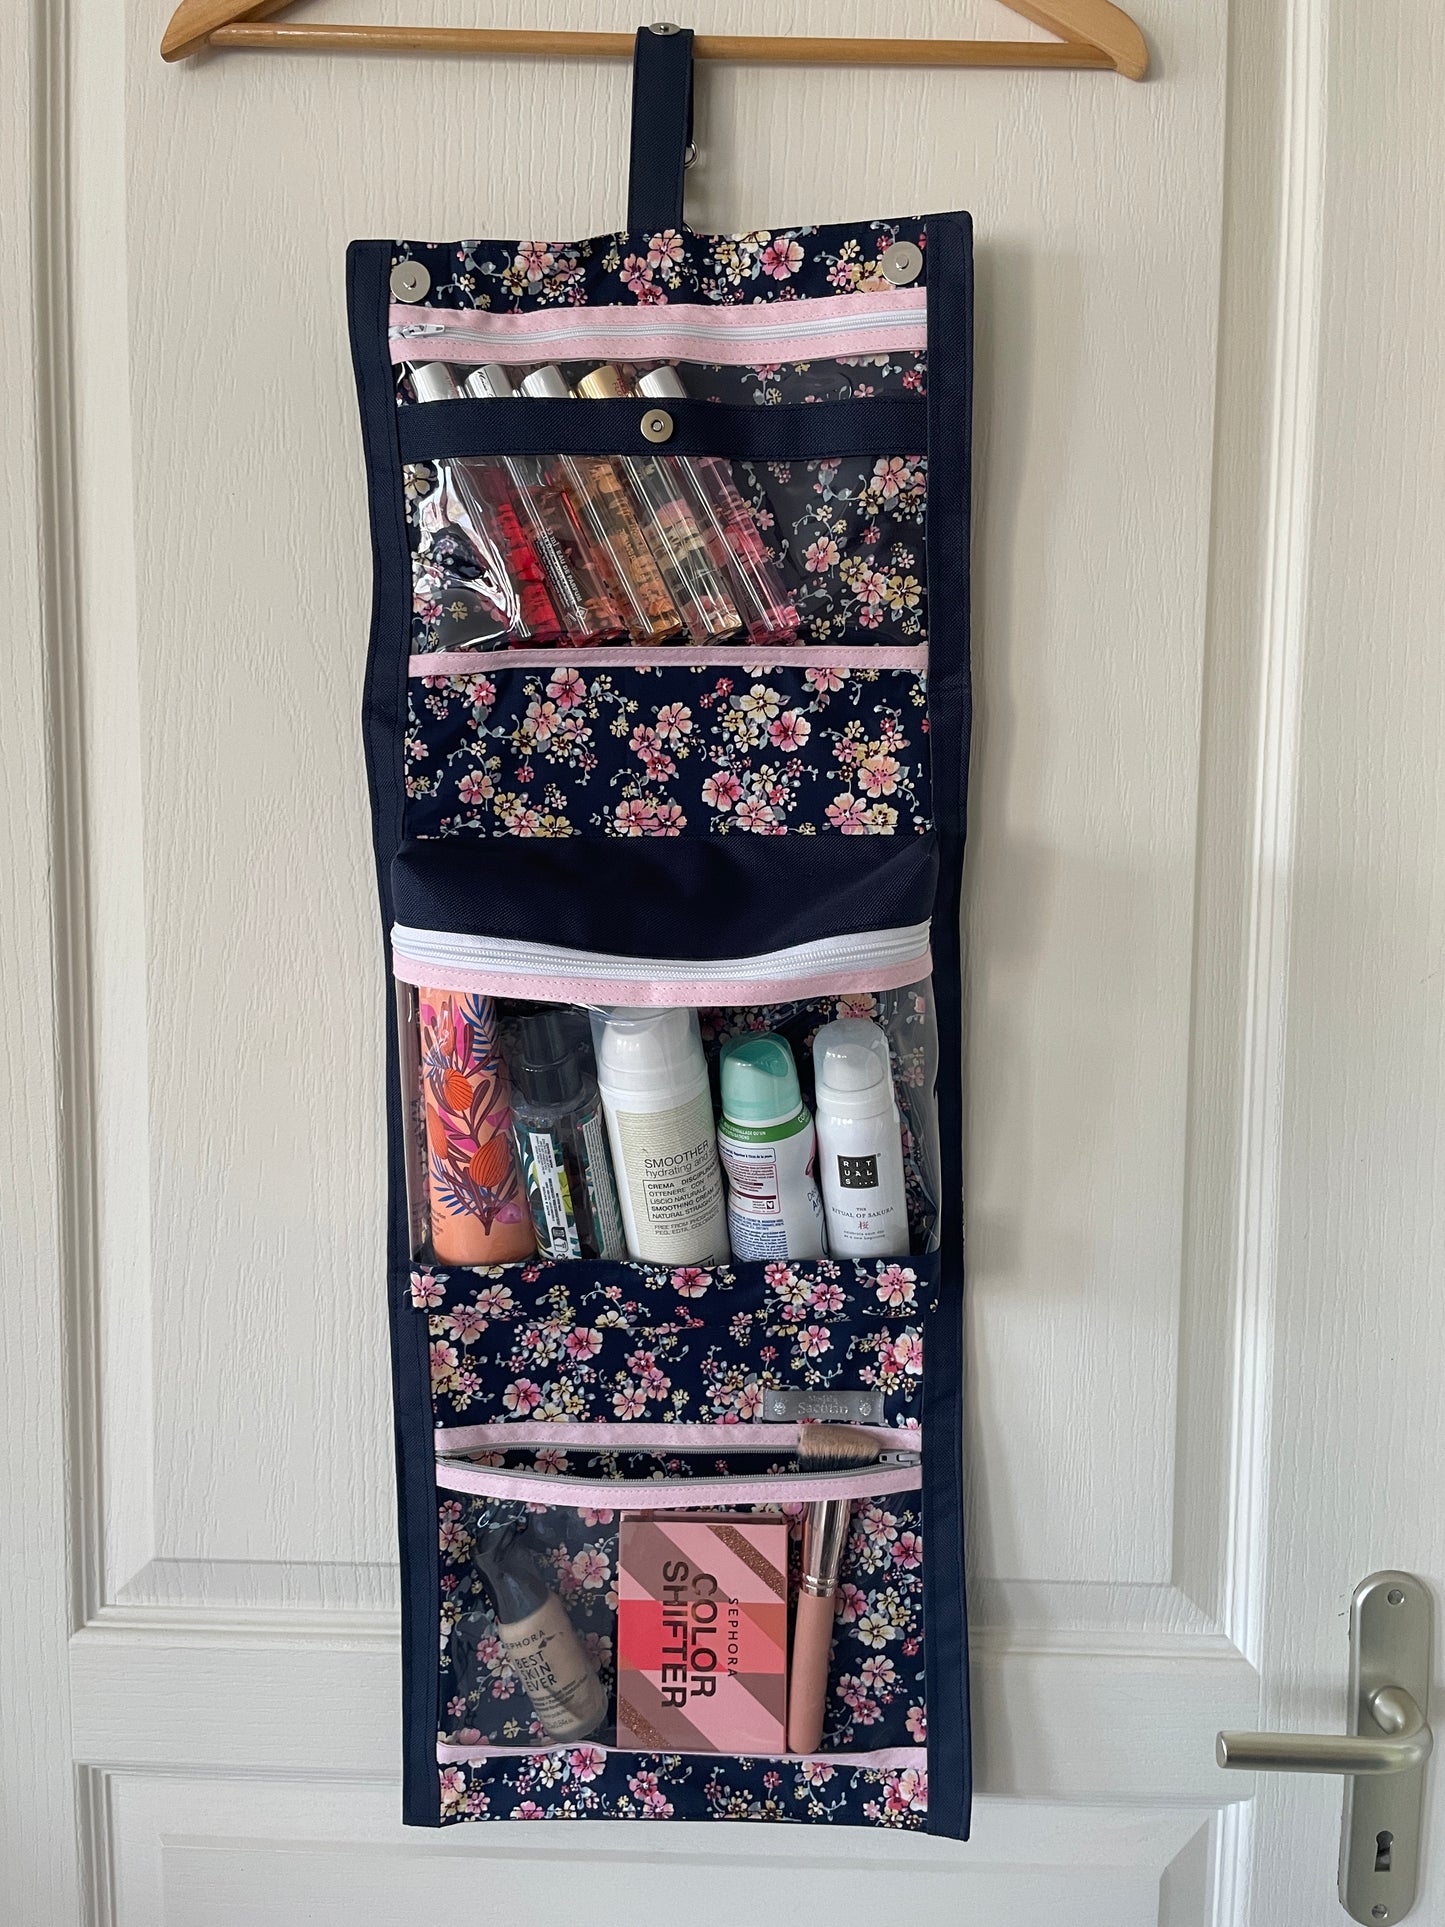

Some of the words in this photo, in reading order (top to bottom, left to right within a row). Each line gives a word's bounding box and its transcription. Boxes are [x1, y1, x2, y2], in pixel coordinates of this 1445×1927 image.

[556, 550, 565, 564] EAU
[563, 565, 570, 574] DE
[567, 575, 582, 602] PARFUM
[644, 1140, 709, 1169] SMOOTHER
[645, 1163, 692, 1179] hydrating
[694, 1151, 709, 1167] and
[691, 1179, 705, 1189] CON
[651, 1200, 694, 1212] SMOOTHING
[652, 1211, 684, 1219] NATURAL
[868, 1206, 894, 1217] SAKURA
[661, 1561, 689, 1708] SHIFTER
[690, 1573, 718, 1697] COLOR
[728, 1598, 738, 1677] SEPHORA
[515, 1650, 544, 1669] BEST
[520, 1662, 551, 1680] SKIN
[526, 1674, 557, 1692] EVER
